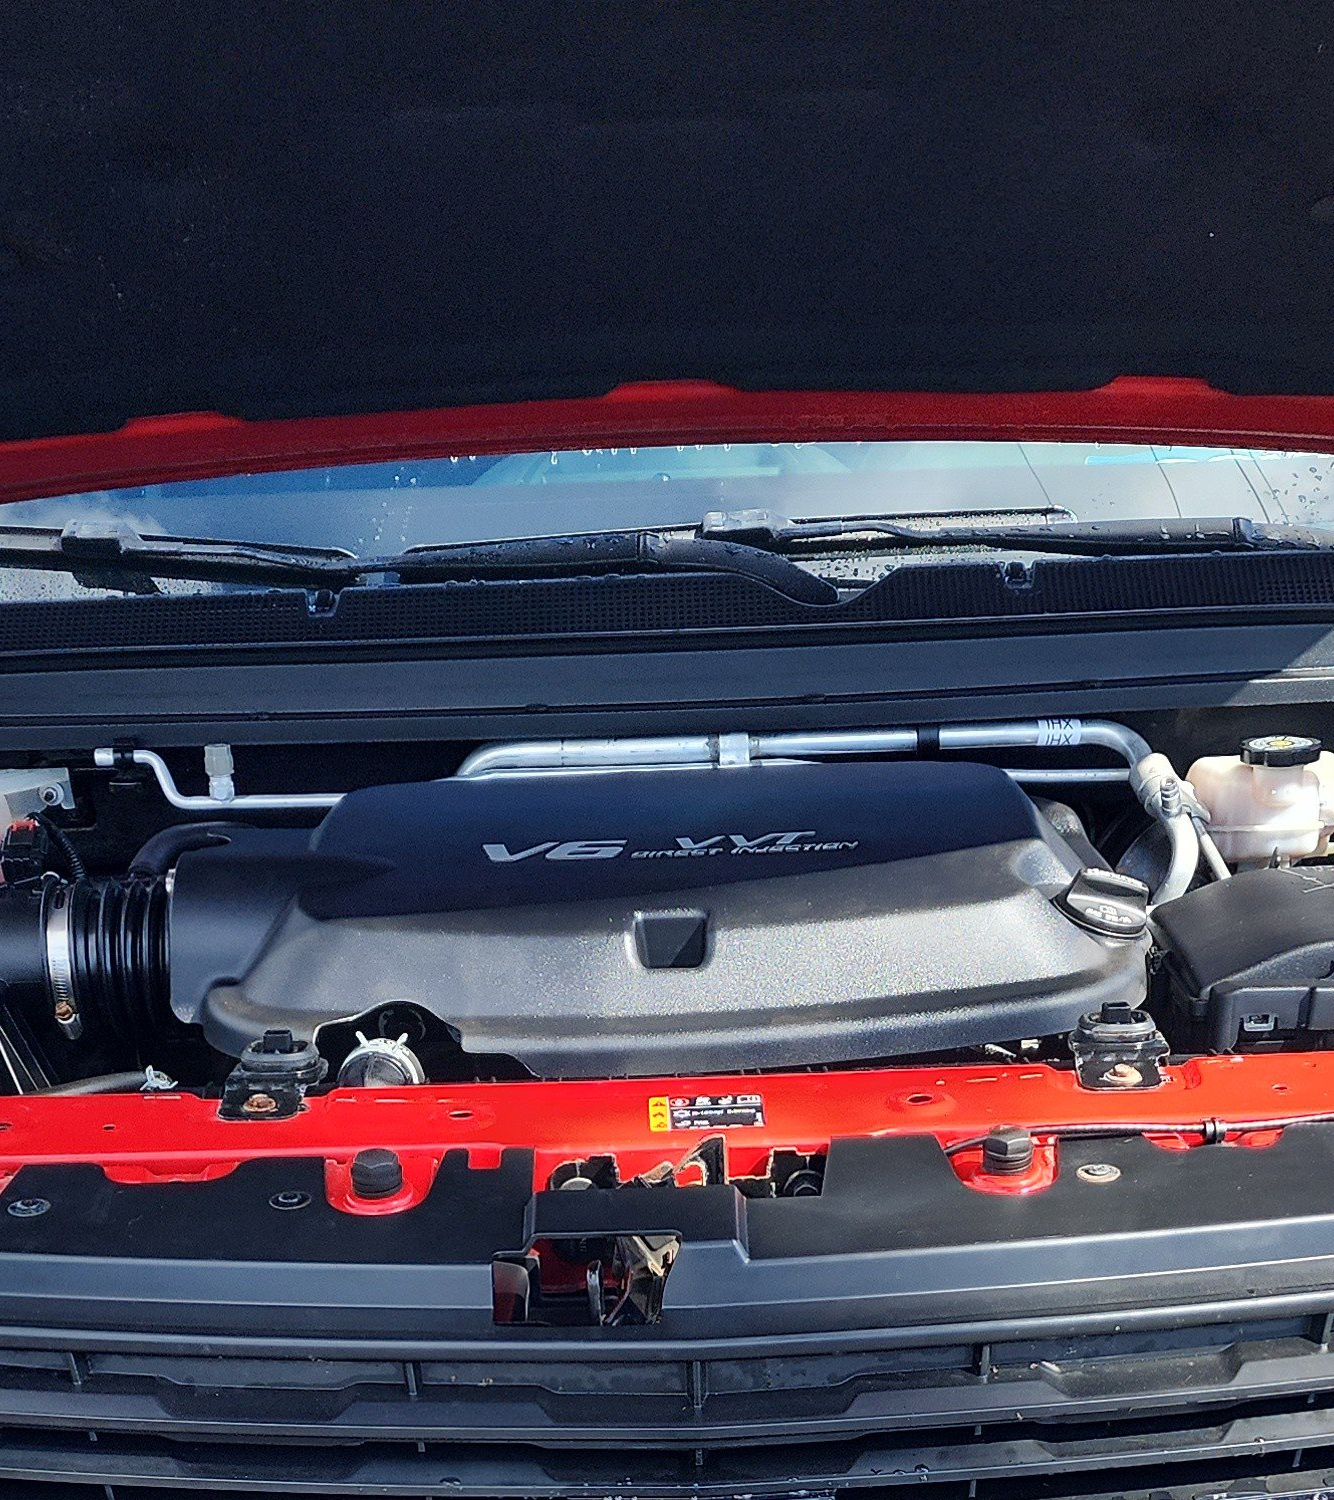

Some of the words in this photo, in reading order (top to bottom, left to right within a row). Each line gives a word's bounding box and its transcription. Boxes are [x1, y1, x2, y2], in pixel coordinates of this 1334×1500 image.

[482, 840, 628, 862] V6
[675, 831, 816, 849] VVT
[730, 841, 859, 855] INJECTION
